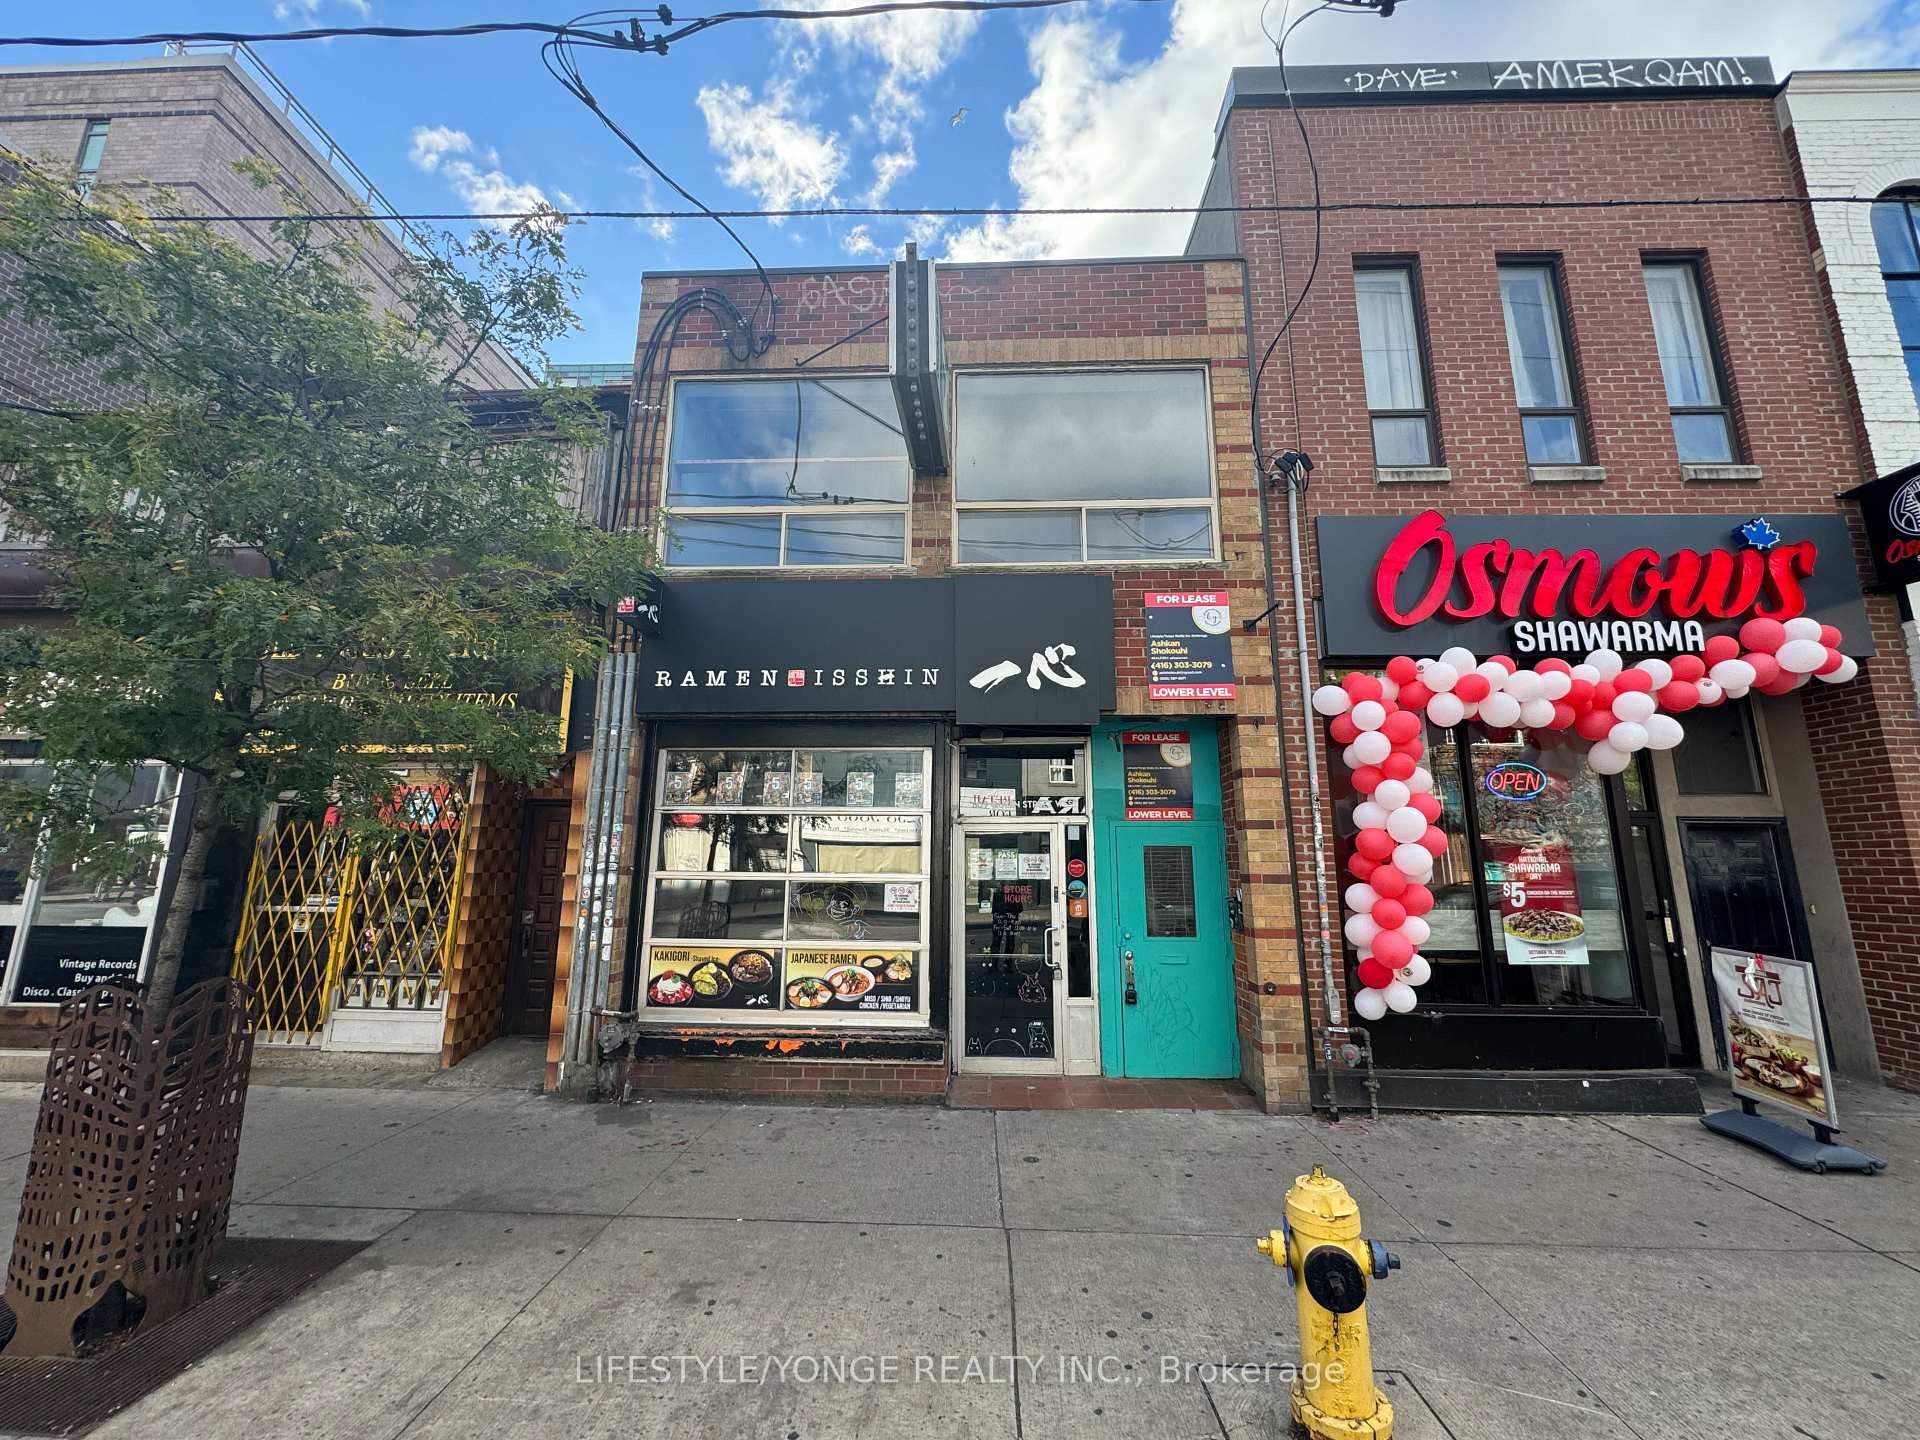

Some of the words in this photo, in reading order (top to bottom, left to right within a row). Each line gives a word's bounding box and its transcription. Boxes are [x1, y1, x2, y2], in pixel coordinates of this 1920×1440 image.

[1156, 595, 1179, 604] FOR
[1181, 594, 1217, 603] LEASE
[1514, 620, 1705, 652] SHAWARMA
[1150, 640, 1181, 648] Ashkan
[1150, 647, 1188, 655] Shokouhi
[968, 643, 1087, 694] 一心
[1151, 662, 1172, 670] (416)
[1174, 661, 1213, 669] 303-3079
[655, 670, 778, 687] RAMEN
[814, 668, 939, 686] ISSHIN
[1153, 688, 1194, 697] LOWER
[1196, 687, 1232, 696] LEVEL
[1152, 733, 1180, 741] LEASE
[1489, 772, 1540, 791] OPEN
[1128, 810, 1161, 819] LOWER
[1163, 810, 1191, 819] LEVEL
[998, 851, 1016, 859] PASS
[1508, 863, 1561, 873] SHAWARMA
[1004, 895, 1033, 903] HOURS
[654, 951, 690, 962] KAKIGORI
[791, 953, 829, 964] JAPANESE
[830, 953, 858, 965] RAMEN
[60, 959, 97, 970] Vintage
[98, 959, 137, 969] Records
[74, 973, 95, 984] Buy
[23, 987, 50, 996] Disco
